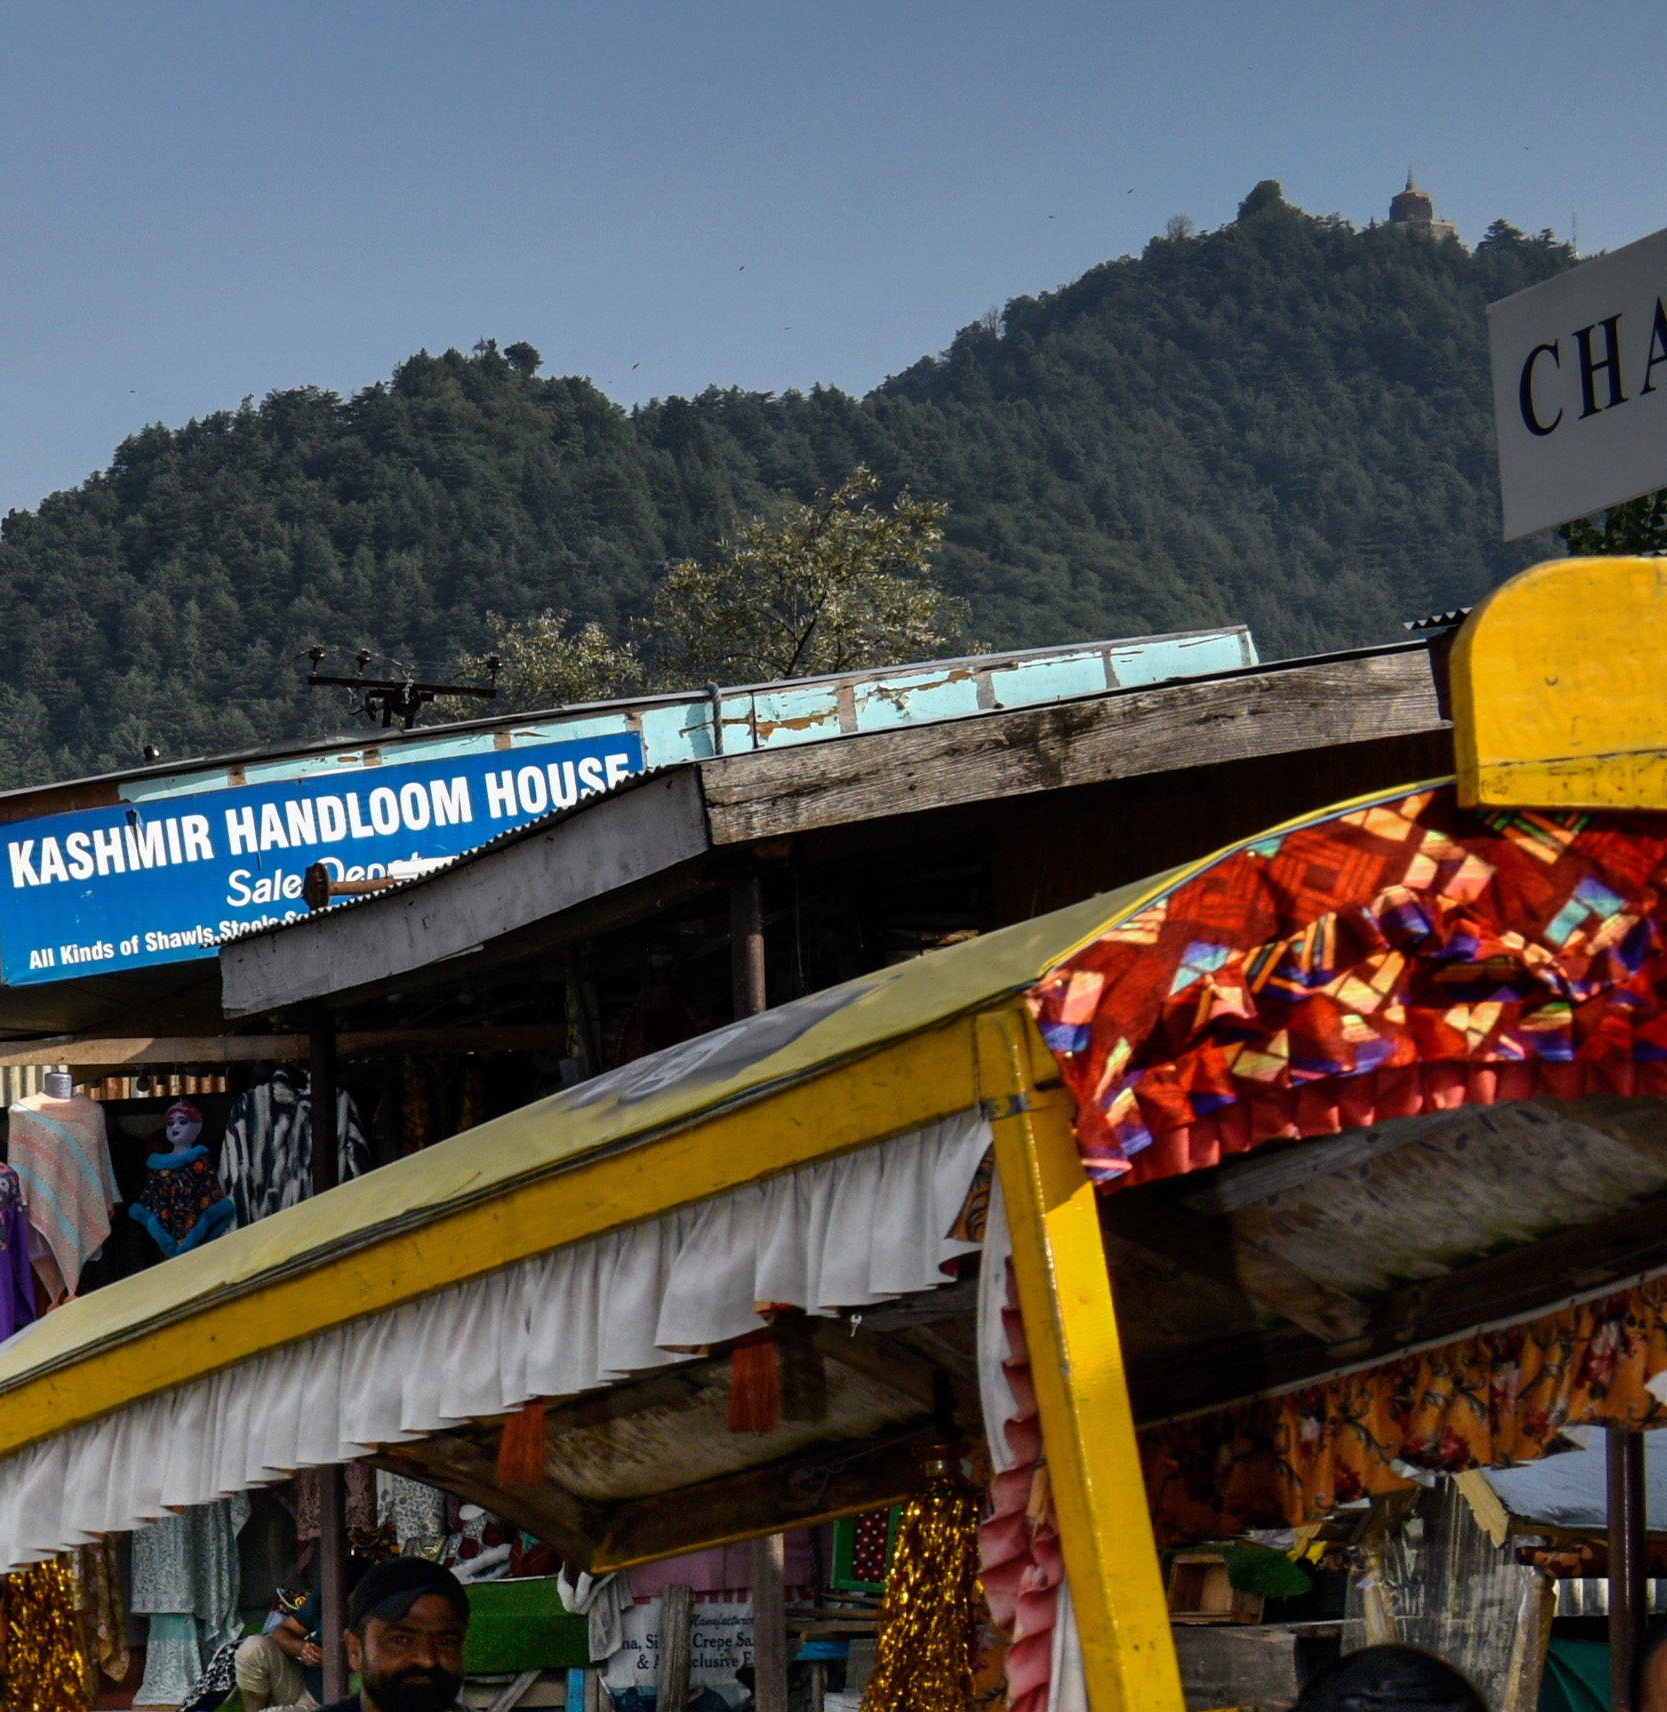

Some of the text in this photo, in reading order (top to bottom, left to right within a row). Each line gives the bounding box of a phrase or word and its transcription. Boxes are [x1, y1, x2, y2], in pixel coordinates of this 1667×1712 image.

[8, 752, 630, 889] KASHMIR HANDLOOM HOUSE
[226, 867, 302, 908] Sale
[28, 949, 55, 970] All
[60, 940, 115, 965] Kinds
[120, 936, 140, 957] of
[692, 1632, 732, 1652] Crepe
[735, 1631, 755, 1648] Sa
[636, 1653, 650, 1670] &
